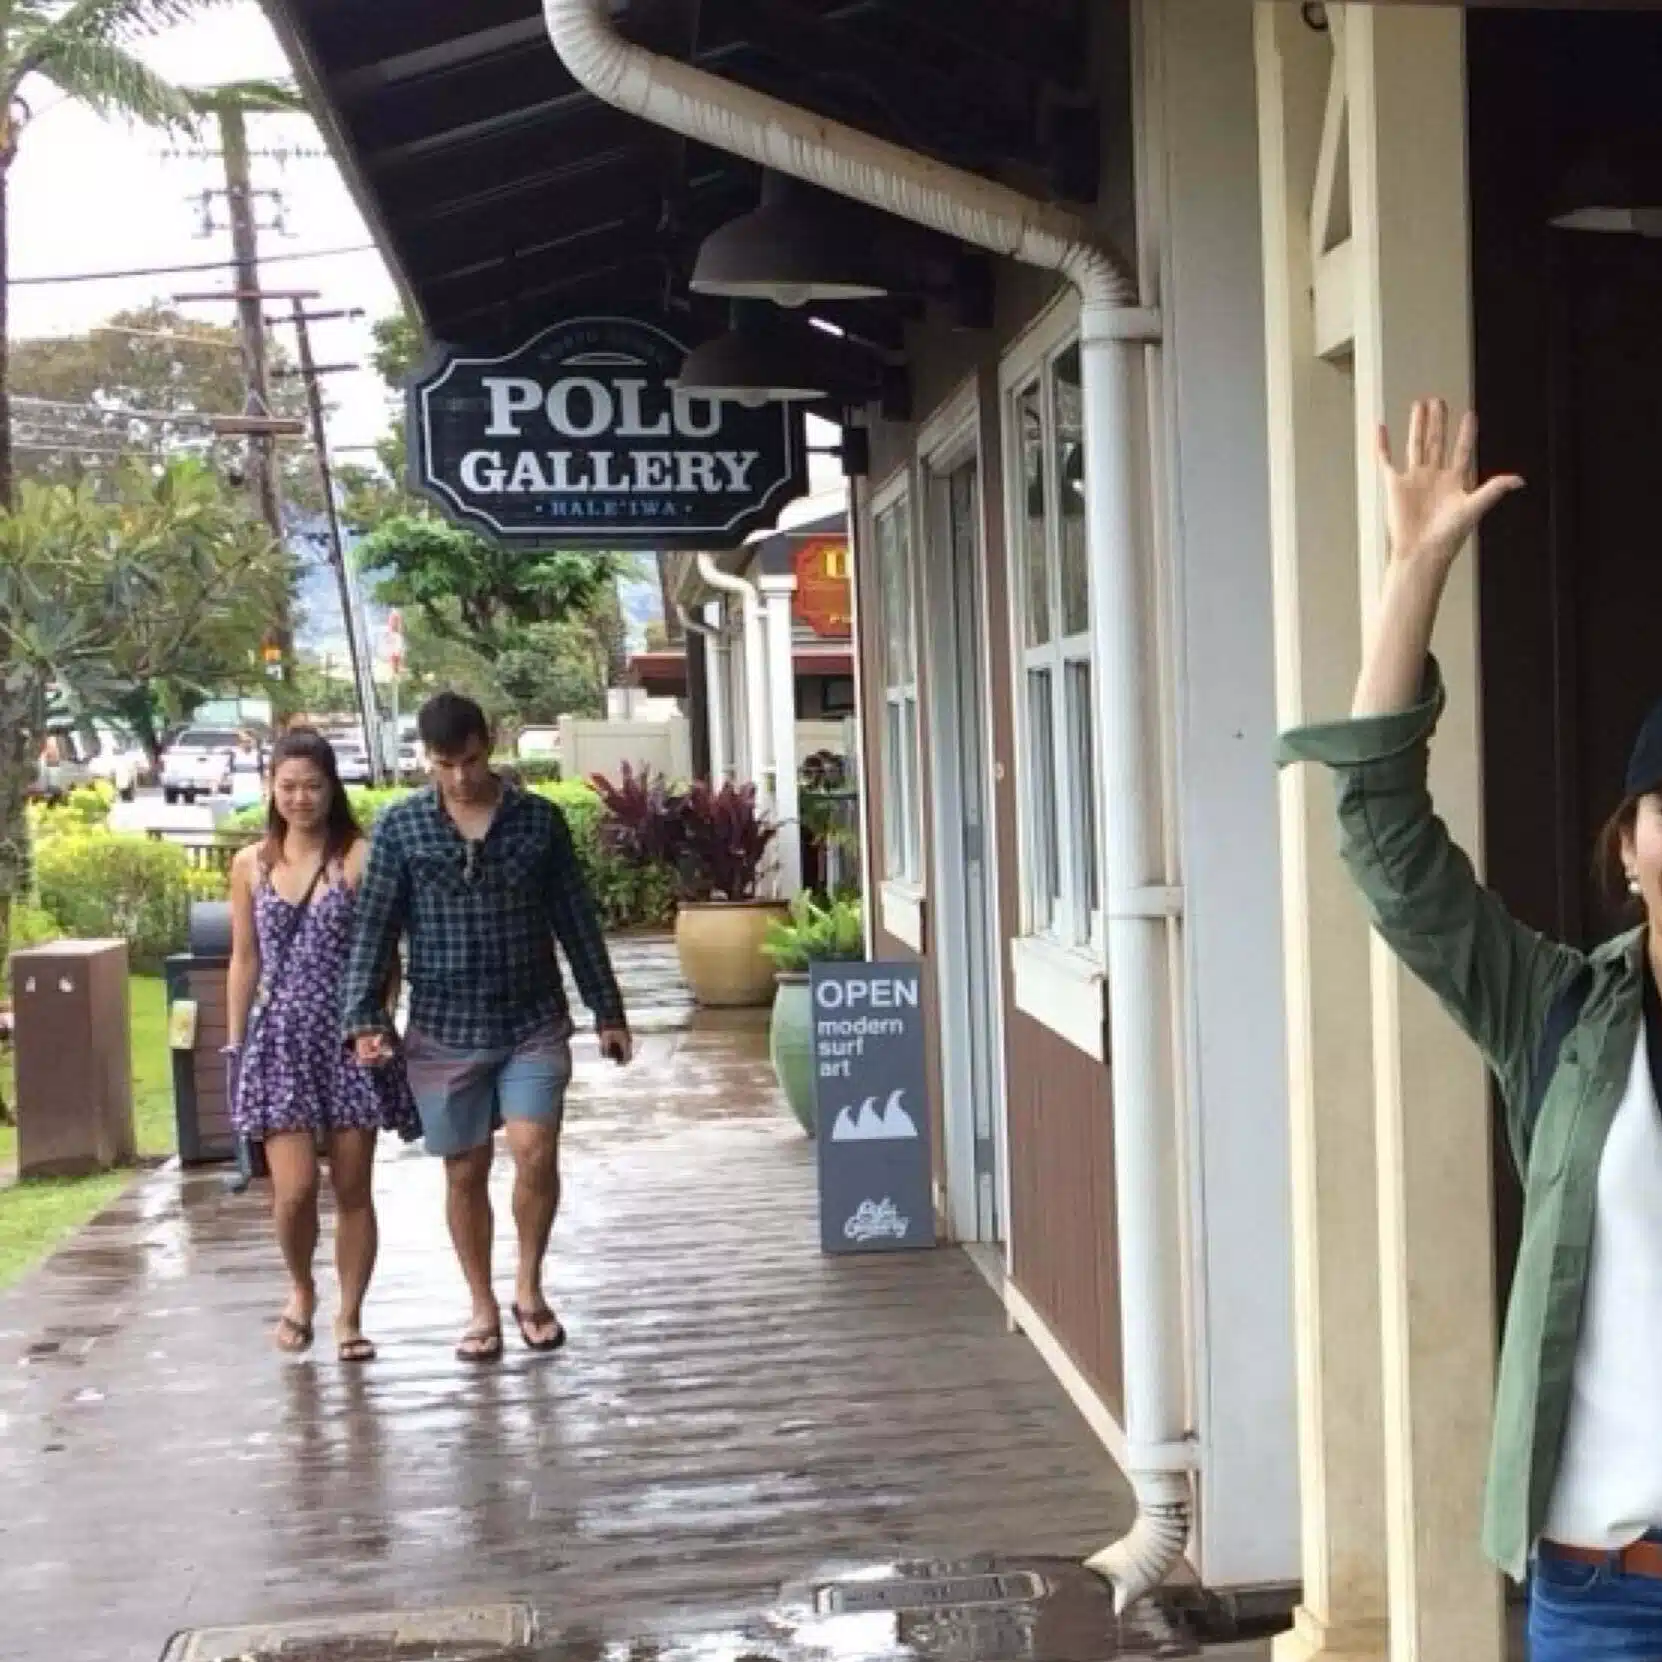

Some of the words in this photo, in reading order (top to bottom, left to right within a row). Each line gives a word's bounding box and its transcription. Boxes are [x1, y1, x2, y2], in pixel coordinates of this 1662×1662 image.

[482, 377, 722, 437] POLU
[460, 450, 760, 493] GALLERY
[816, 979, 919, 1008] OPEN
[817, 1016, 904, 1035] modern
[818, 1036, 864, 1056] surf
[820, 1058, 851, 1077] art
